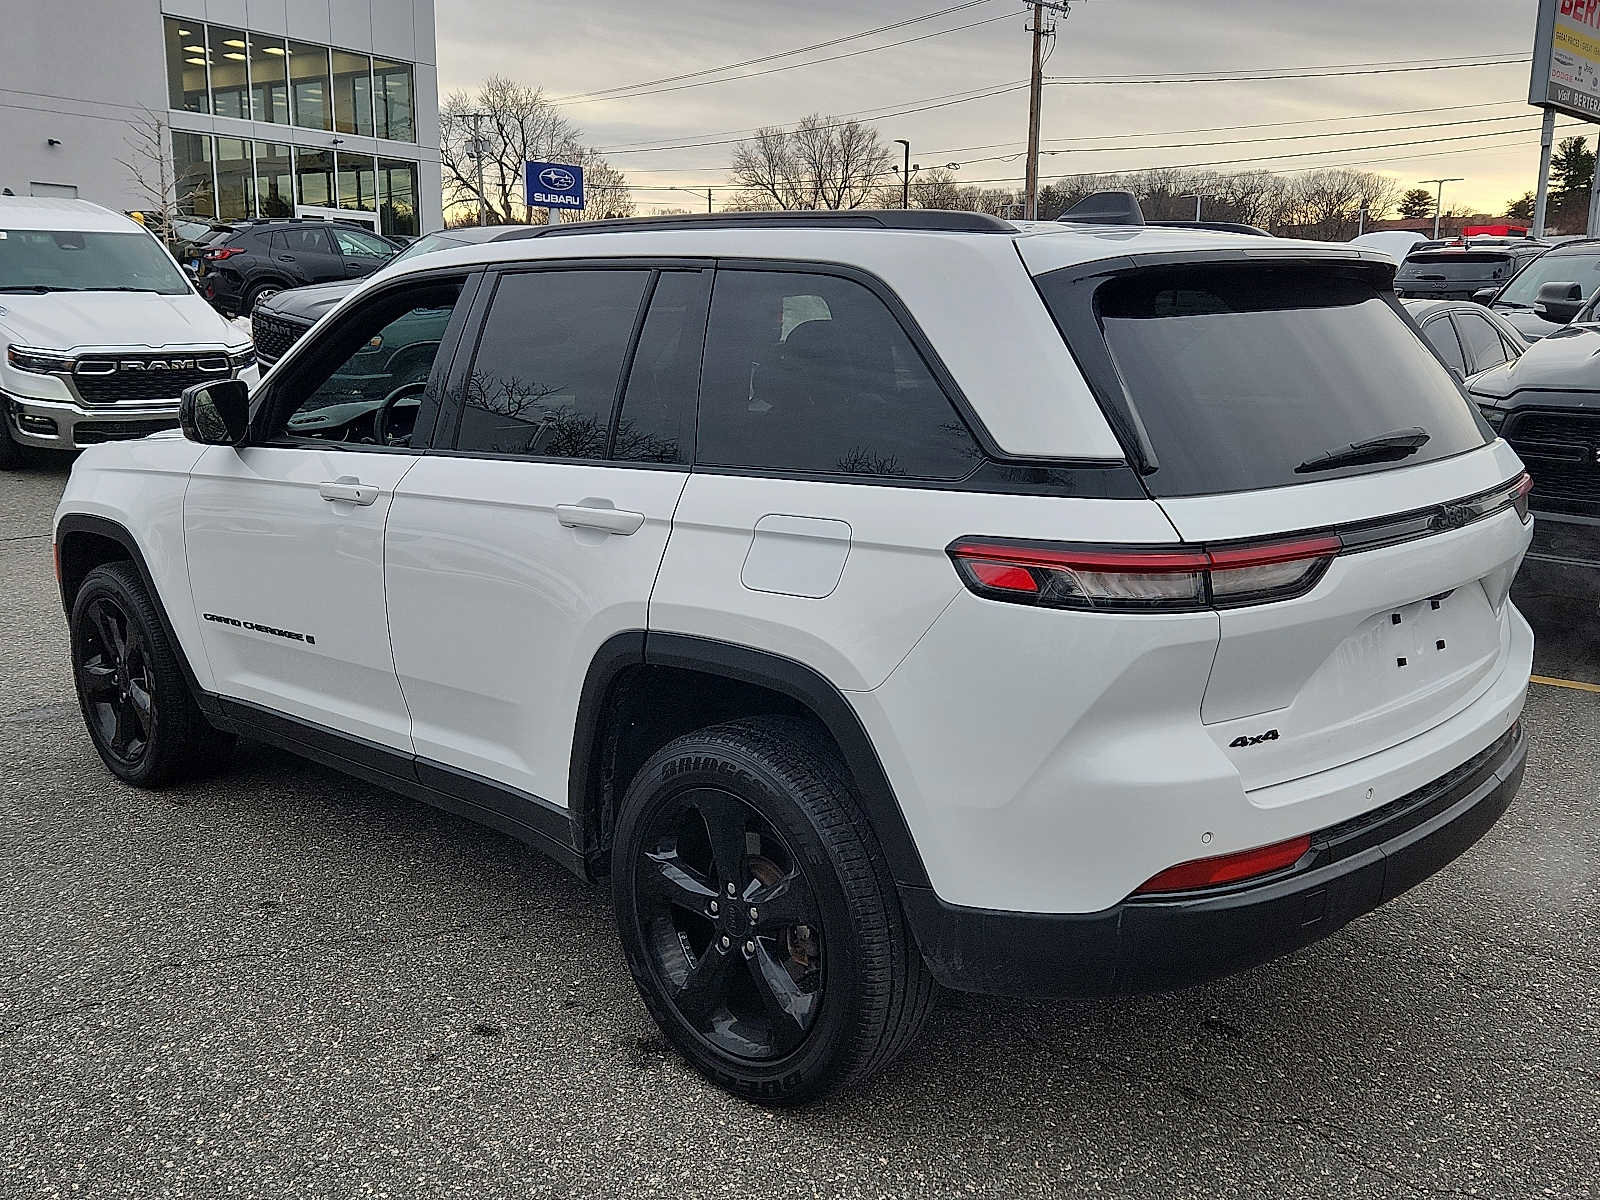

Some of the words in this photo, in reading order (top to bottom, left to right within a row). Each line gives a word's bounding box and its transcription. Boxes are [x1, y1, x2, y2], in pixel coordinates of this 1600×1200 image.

[534, 193, 579, 205] SUBARU
[121, 360, 194, 371] RAM
[203, 613, 241, 628] GRAND
[243, 622, 304, 641] CHEROKEE
[1229, 729, 1280, 747] 4x4
